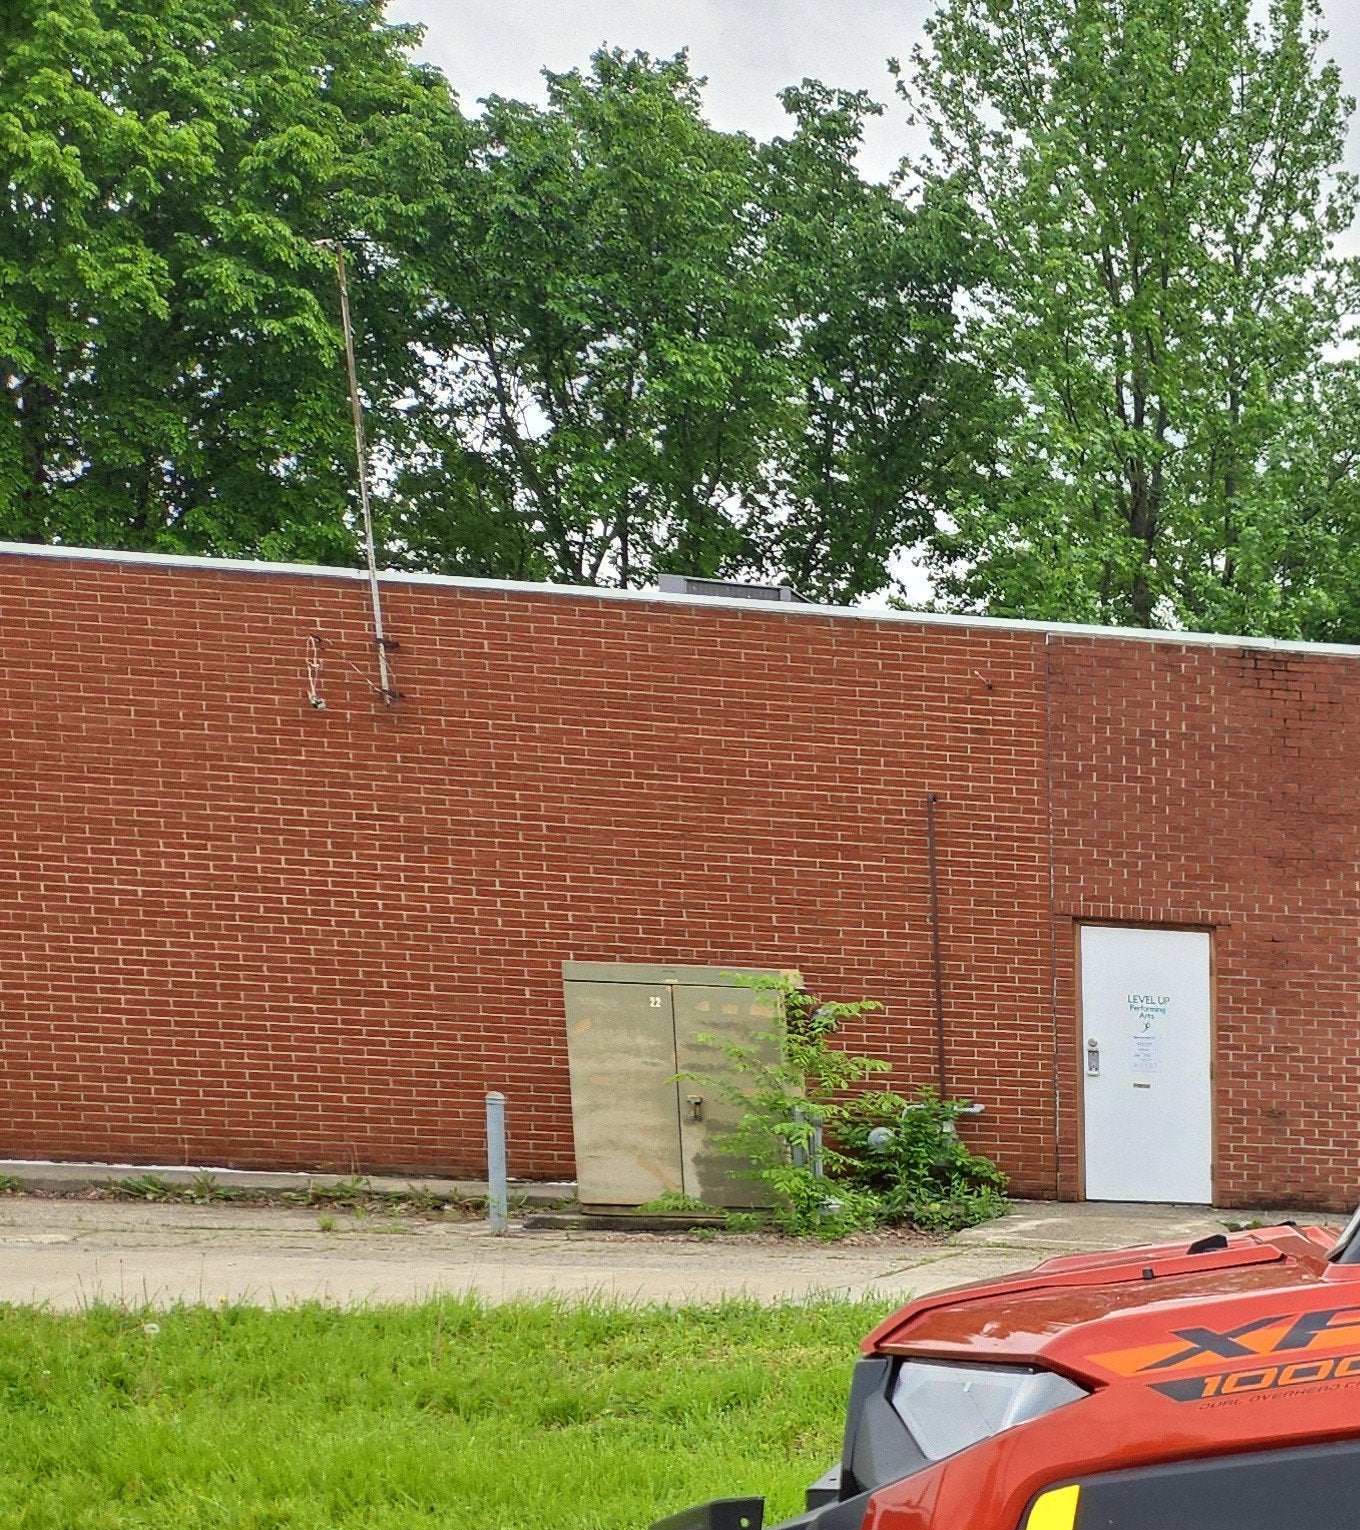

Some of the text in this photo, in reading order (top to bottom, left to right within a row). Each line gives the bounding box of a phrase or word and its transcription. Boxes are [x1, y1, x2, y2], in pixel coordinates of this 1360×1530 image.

[649, 996, 661, 1007] 22
[1127, 994, 1170, 1005] LEVEL UP
[1199, 1399, 1242, 1410] DUAL
[1249, 1384, 1341, 1402] OVERHEAD
